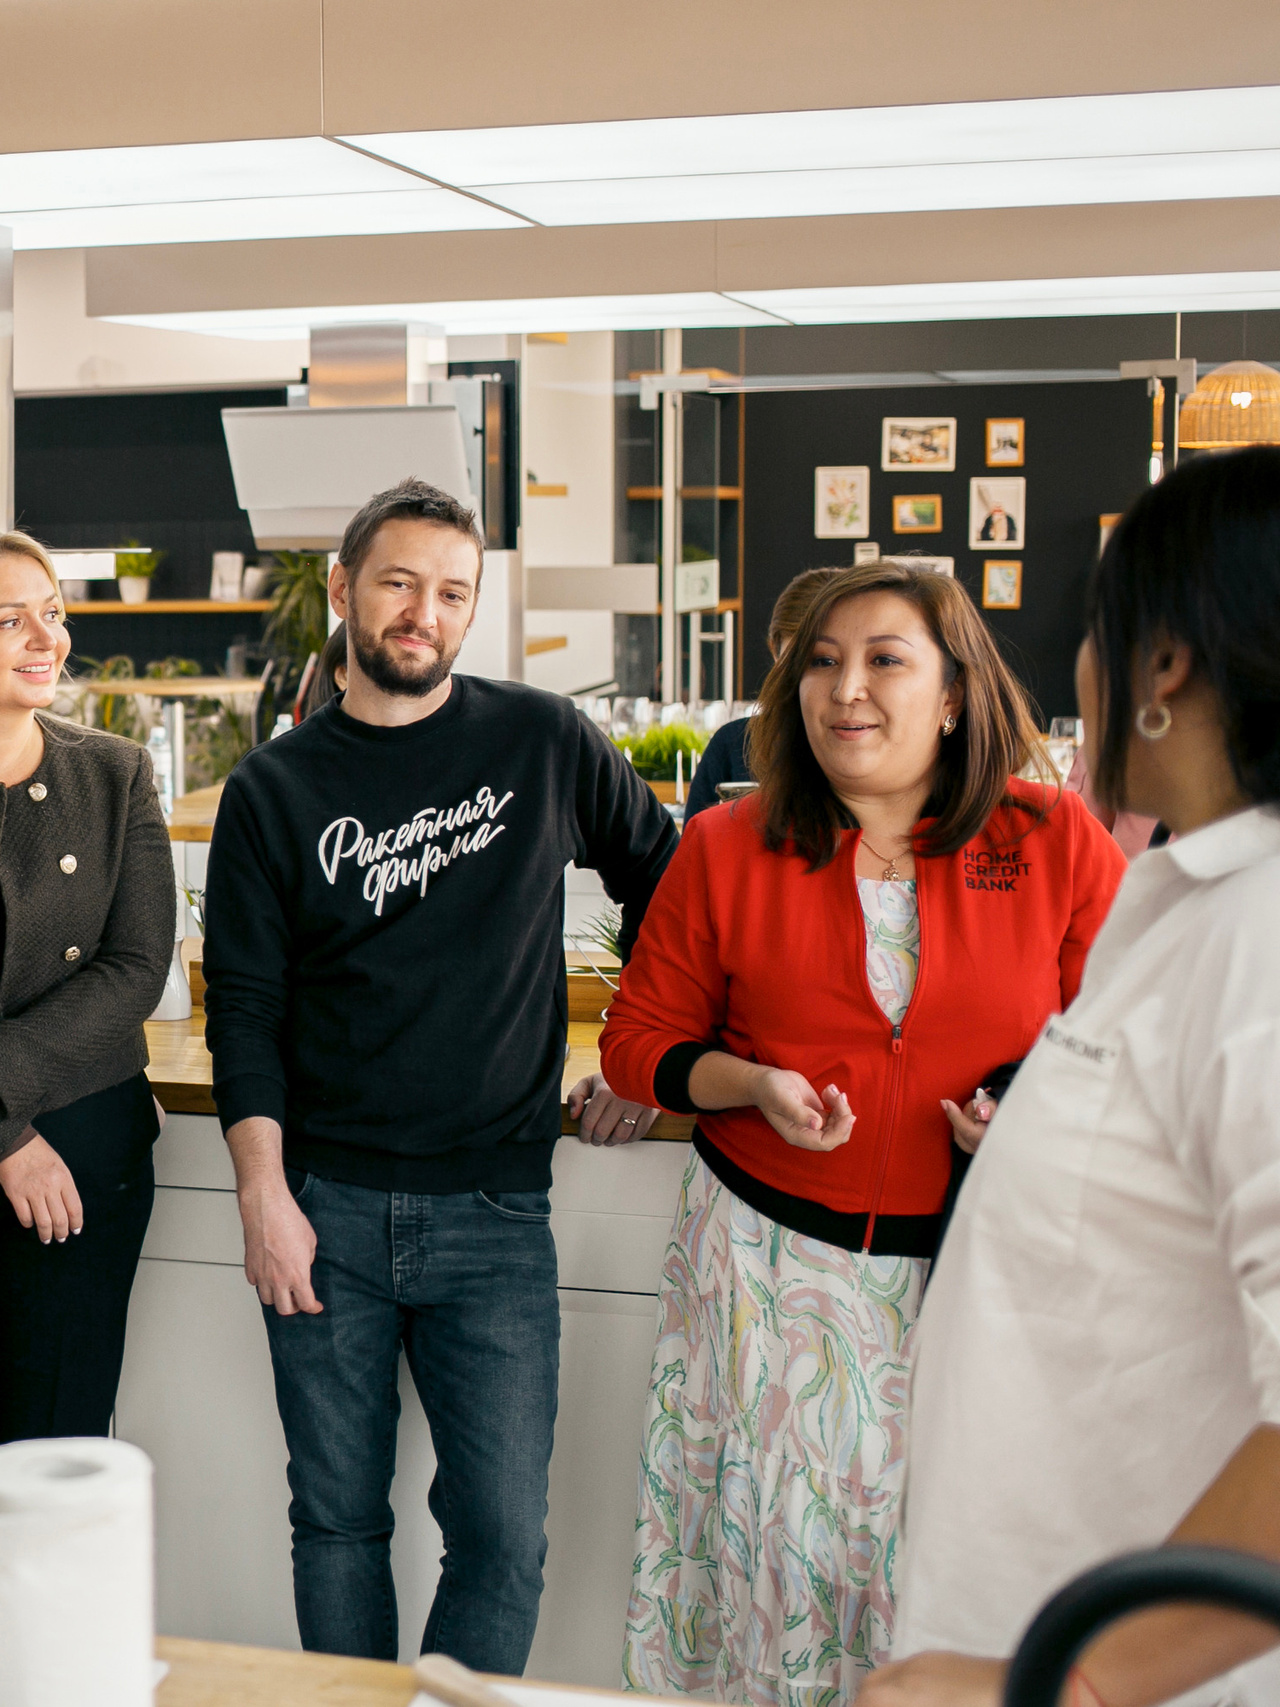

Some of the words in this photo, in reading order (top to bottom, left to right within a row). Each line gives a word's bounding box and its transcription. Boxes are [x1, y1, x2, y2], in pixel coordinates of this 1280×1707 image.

[318, 786, 514, 885] Ракетная
[964, 848, 1023, 865] HOME
[363, 822, 506, 917] фирма
[964, 863, 1032, 877] CREDIT
[965, 876, 1017, 892] BANK
